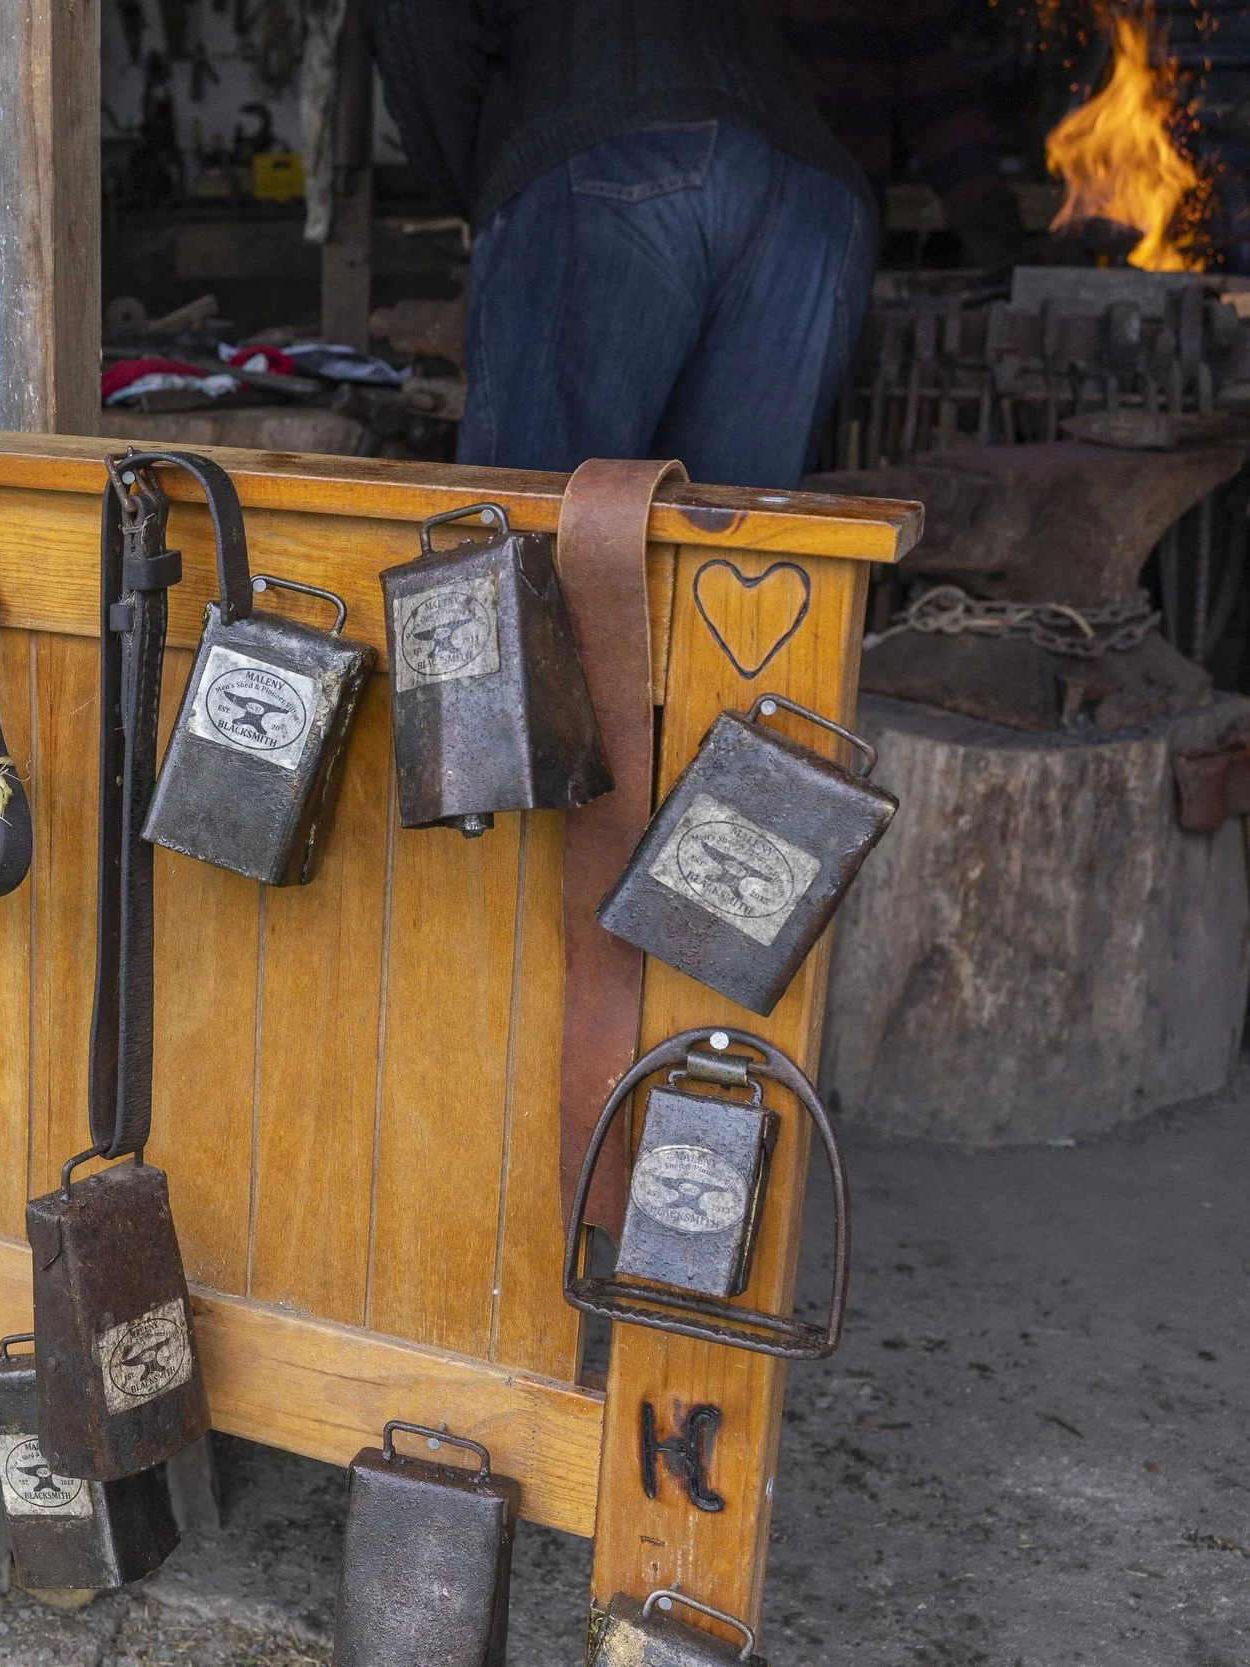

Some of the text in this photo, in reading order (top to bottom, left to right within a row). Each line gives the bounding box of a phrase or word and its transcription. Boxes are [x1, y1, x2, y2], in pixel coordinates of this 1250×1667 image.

[215, 682, 236, 693] Men's
[245, 670, 285, 690] MALENY
[217, 720, 278, 748] BLACKSMITH
[686, 870, 755, 916] BLACKSMITH
[650, 1204, 720, 1229] BLACKSMITH
[710, 1203, 731, 1215] 2013
[130, 1366, 176, 1394] BLACKSMITH
[24, 1492, 72, 1500] BLACKSMITH
